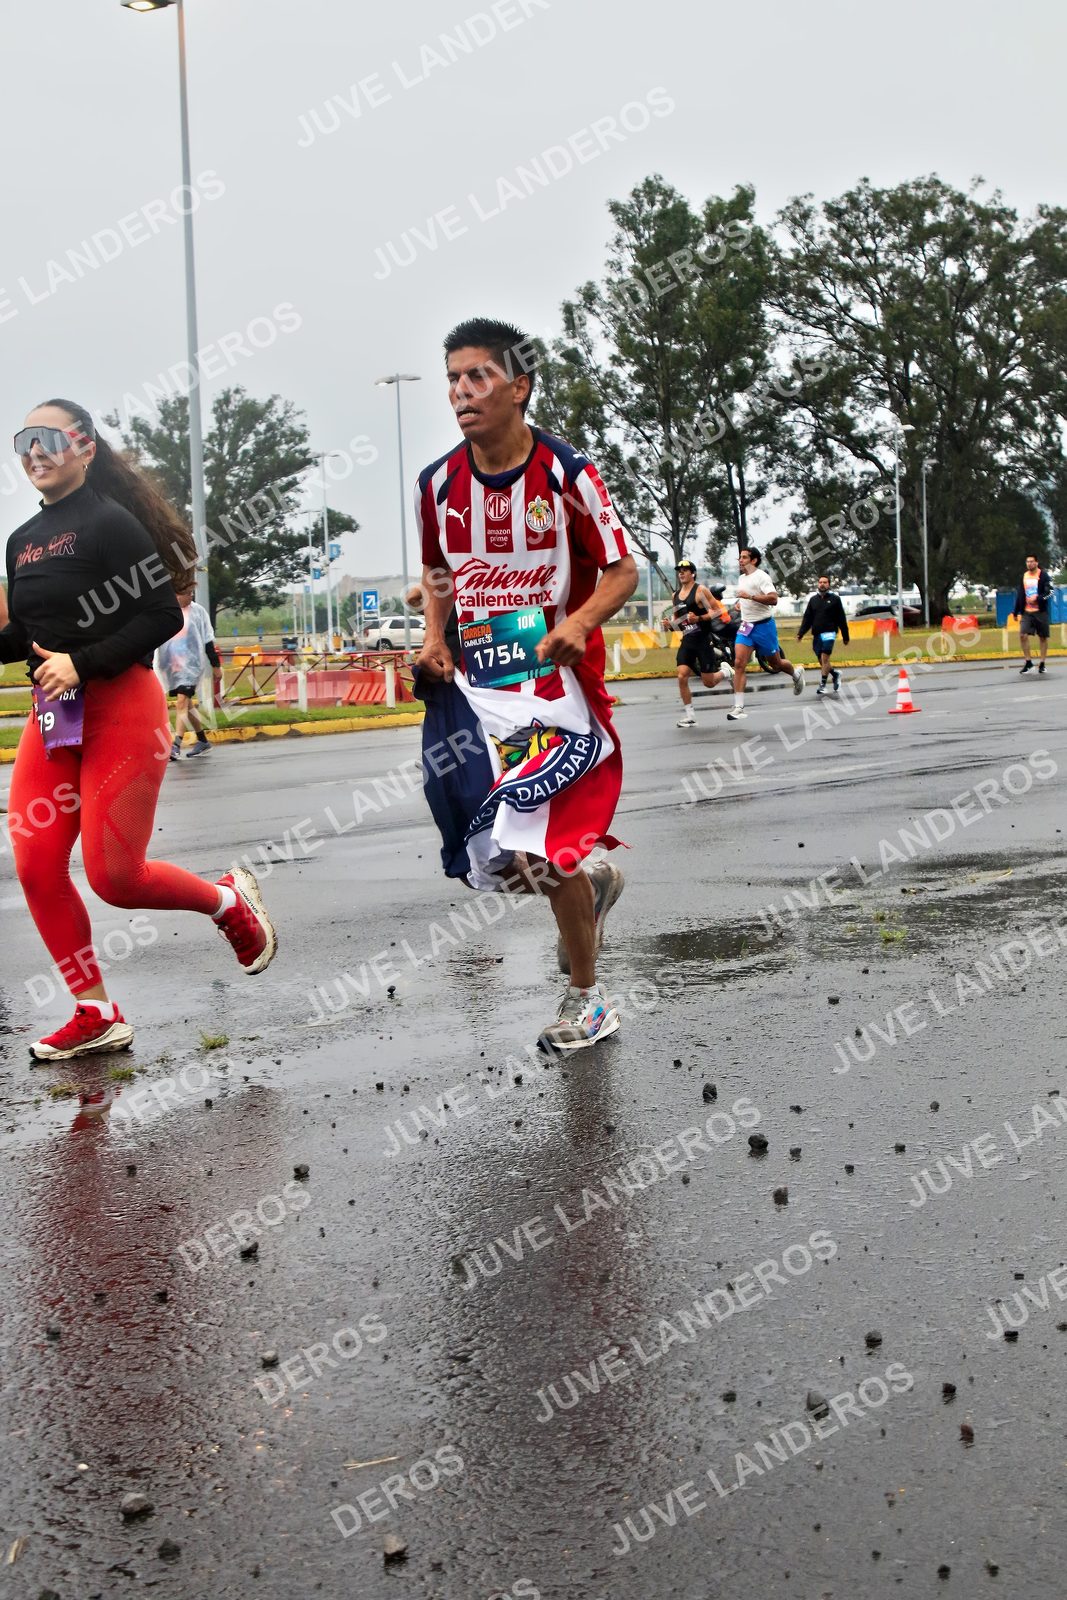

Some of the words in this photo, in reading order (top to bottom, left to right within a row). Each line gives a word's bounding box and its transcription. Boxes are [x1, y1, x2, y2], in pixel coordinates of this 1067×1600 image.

[490, 535, 508, 543] prime
[453, 558, 557, 592] Caliente
[459, 589, 552, 608] caliente.mx
[517, 614, 536, 630] 10K
[463, 624, 492, 640] CARRERA
[464, 636, 486, 648] OMNILIFE
[473, 642, 526, 669] 1754
